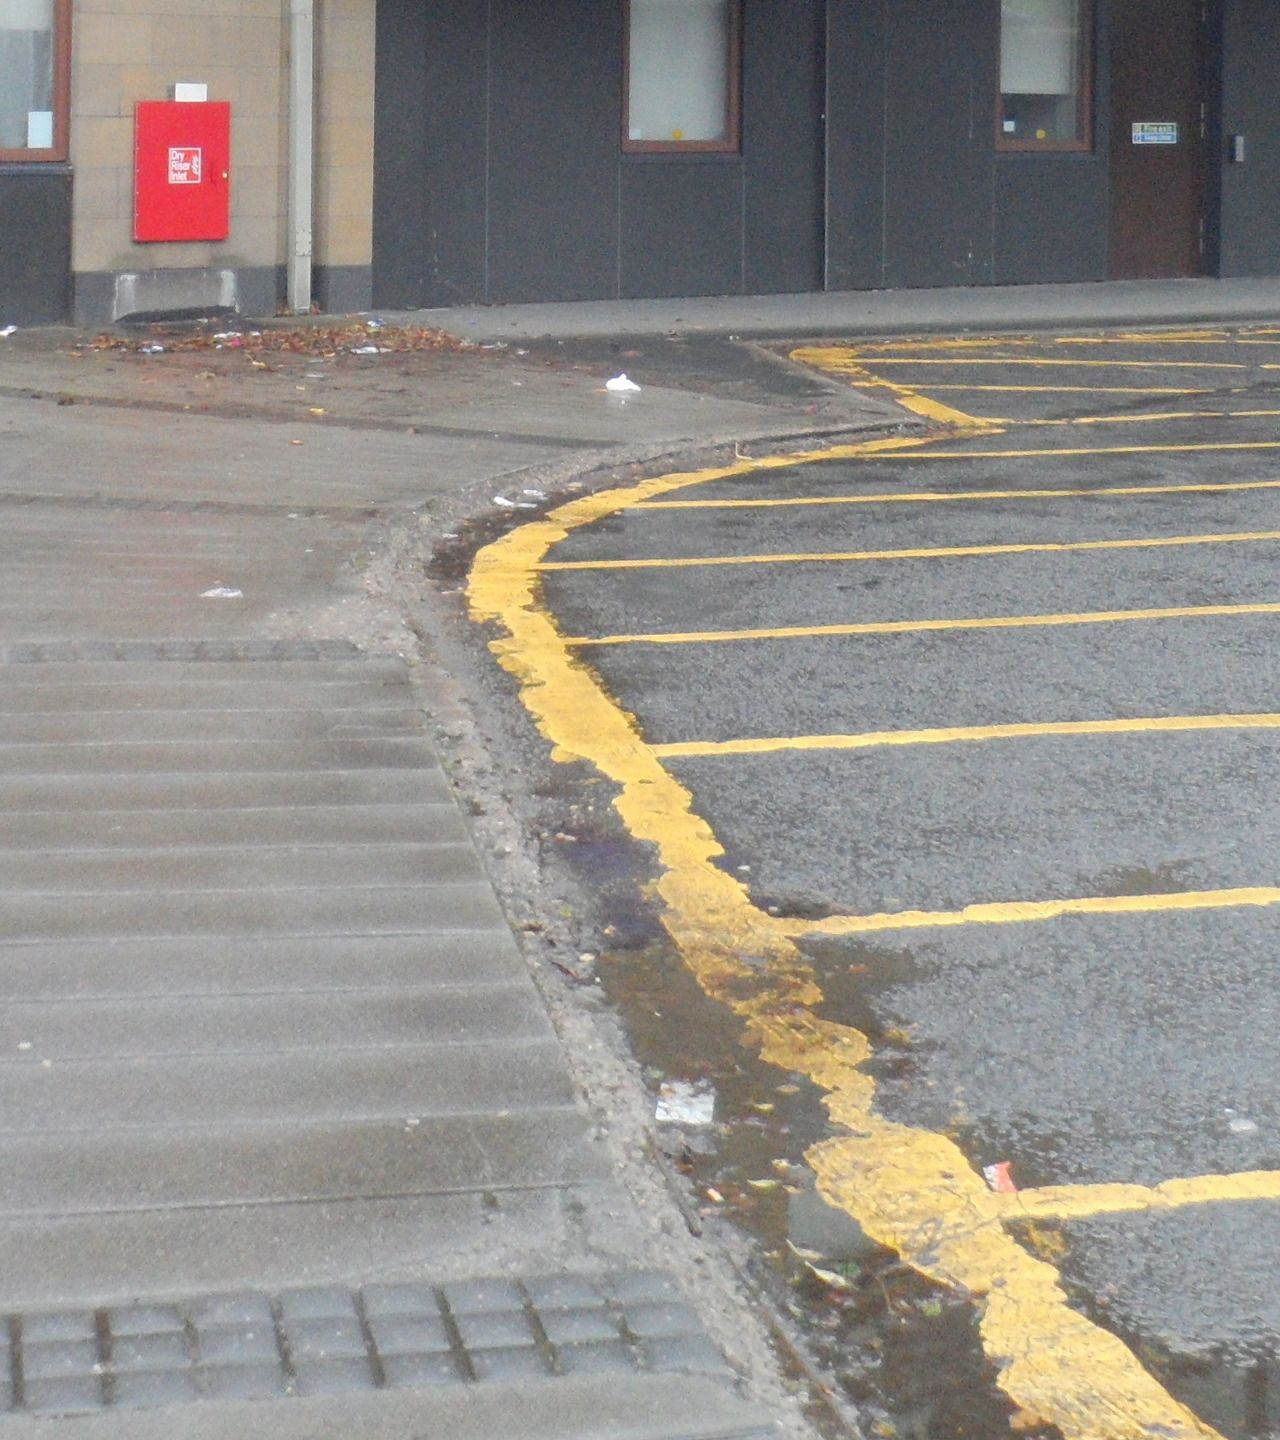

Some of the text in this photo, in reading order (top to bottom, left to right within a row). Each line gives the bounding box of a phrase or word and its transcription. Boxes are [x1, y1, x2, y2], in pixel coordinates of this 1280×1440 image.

[172, 150, 185, 162] Dry
[172, 161, 190, 170] Riser
[172, 171, 187, 180] Inlet
